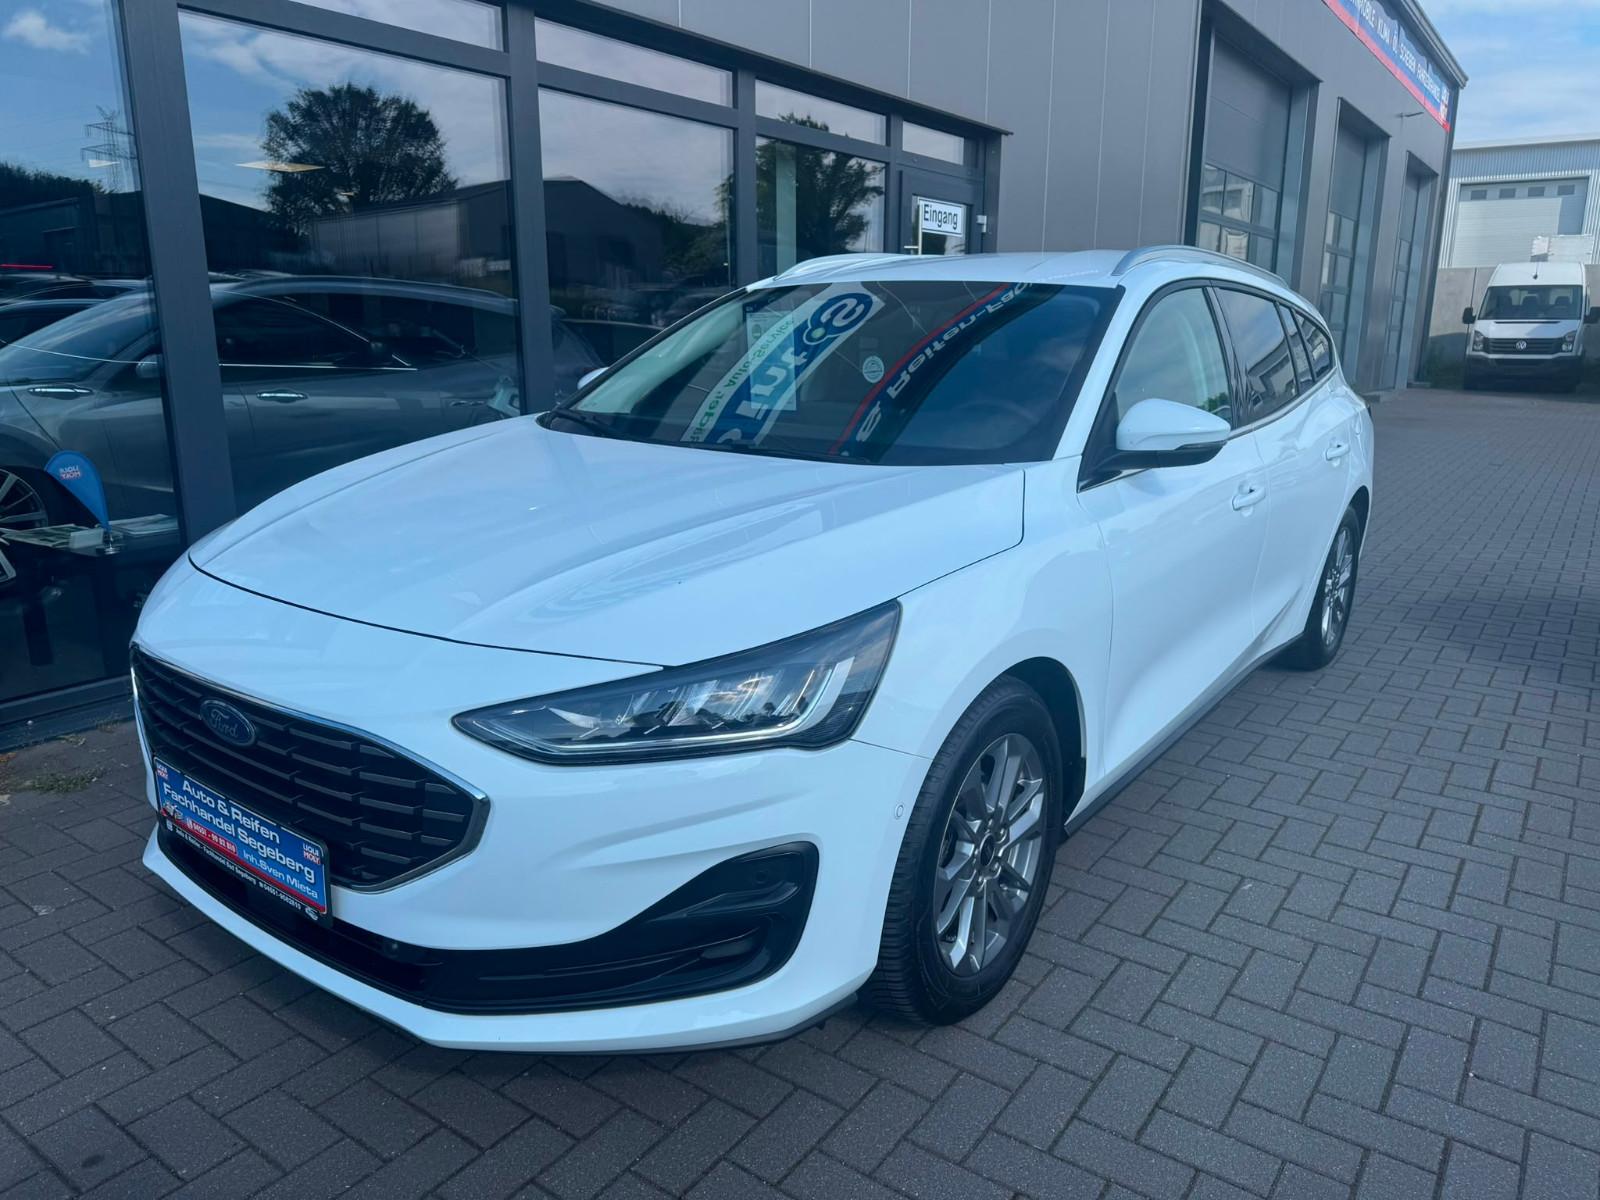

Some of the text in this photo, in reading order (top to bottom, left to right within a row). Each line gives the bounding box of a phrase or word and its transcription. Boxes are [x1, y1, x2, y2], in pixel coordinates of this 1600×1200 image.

[923, 203, 958, 230] Eingang
[210, 708, 239, 739] Ford
[162, 782, 316, 884] Fachhandel Segeberg
[182, 780, 281, 844] Auto & Reifen
